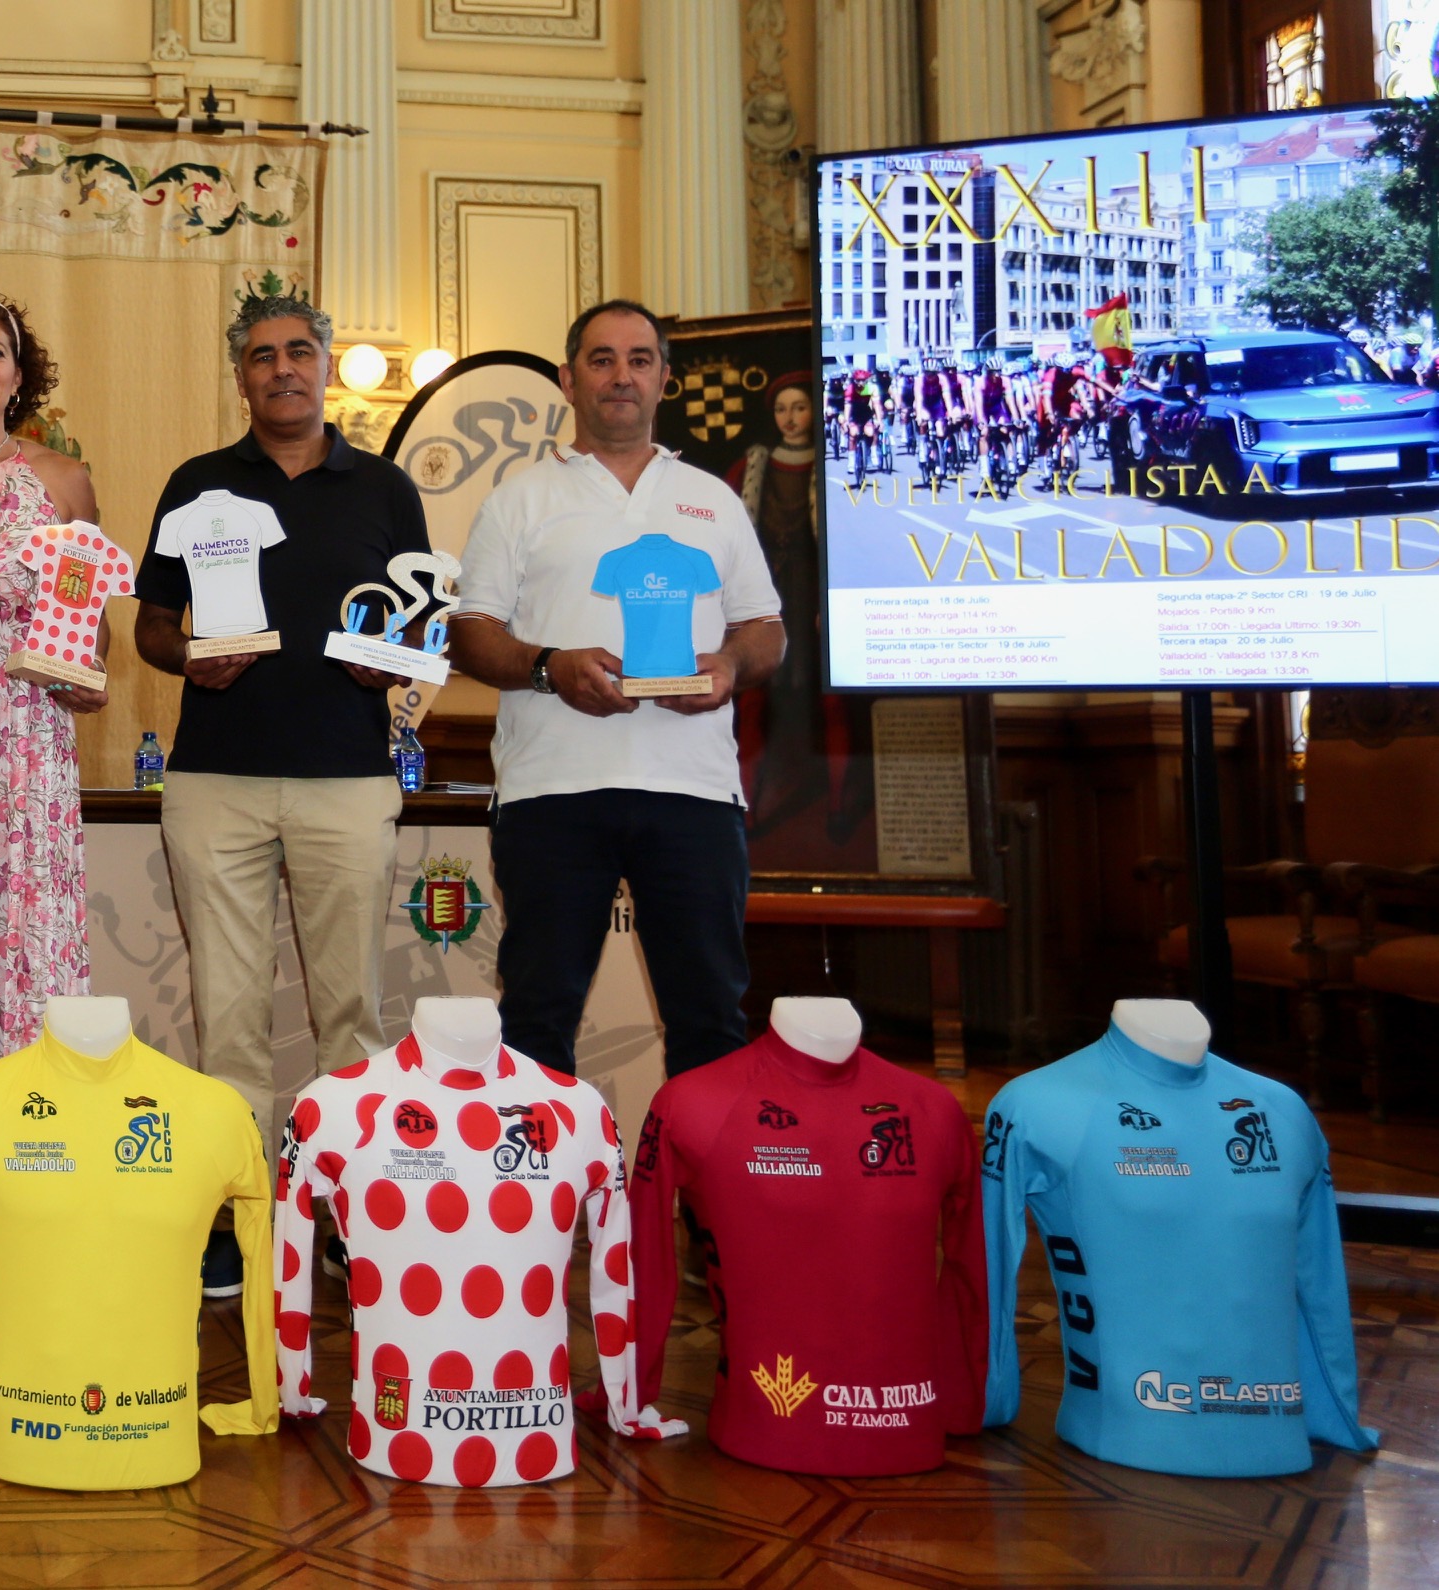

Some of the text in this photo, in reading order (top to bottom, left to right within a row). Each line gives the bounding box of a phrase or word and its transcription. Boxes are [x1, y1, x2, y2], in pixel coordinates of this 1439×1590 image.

[894, 158, 968, 173] CAJA RURAL
[840, 146, 1209, 253] XXXIII
[844, 462, 1275, 507] VUELTA CICLISTA A
[678, 505, 714, 518] LORD
[192, 539, 249, 550] ALIMENTOS
[906, 517, 1439, 582] VALLADOLID
[63, 548, 97, 564] PORTILLO
[205, 548, 249, 557] VALLADOLID
[206, 560, 223, 569] gusto
[865, 598, 900, 606] Primera
[903, 598, 929, 606] etapa
[968, 596, 990, 604] Julio
[1157, 592, 1202, 602] Segunda
[1251, 591, 1284, 599] Sector
[1288, 590, 1308, 598] CRI
[1320, 590, 1332, 598] 19
[1335, 589, 1348, 597] de
[1352, 589, 1376, 597] Julio
[866, 612, 908, 620] Valladolid
[918, 612, 958, 621] Mayorga
[981, 610, 997, 618] Km
[1157, 608, 1200, 617] Mojados
[1210, 607, 1244, 615] Portillo
[1258, 606, 1275, 614] Km
[1240, 622, 1281, 631] Llegada
[1326, 620, 1361, 628] 19:30h
[866, 642, 906, 651] Segunda
[957, 641, 987, 649] Sector
[999, 640, 1009, 648] 19
[1012, 640, 1024, 648] de
[1027, 640, 1050, 648] Julio
[1159, 637, 1195, 645] Tercera
[1199, 638, 1227, 646] etapa
[1253, 636, 1265, 644] de
[1269, 636, 1294, 644] Julio
[866, 656, 911, 664] Simancas
[920, 656, 955, 665] Laguna
[958, 655, 970, 663] de
[973, 655, 1002, 663] Duero
[1159, 652, 1207, 660] Valladolid
[1217, 651, 1266, 659] Valladolid
[1159, 667, 1191, 676] Salida:
[1198, 667, 1216, 675] 10h
[1274, 667, 1309, 675] 13:30h
[38, 1142, 66, 1150] CICLISTA
[753, 1146, 810, 1155] VUELTA CICLISTA
[390, 1149, 446, 1159] VUELTA CICLISTA
[4, 1158, 75, 1172] VALLADOLID
[746, 1162, 822, 1176] VALLADOLID
[1115, 1162, 1191, 1176] VALLADOLID
[383, 1165, 456, 1180] VALLADOLID
[116, 1391, 132, 1407] de
[135, 1383, 187, 1405] Valladolid
[423, 1388, 545, 1404] AYUNTAMIENTO
[823, 1380, 936, 1409] CAJA RURAL
[1200, 1382, 1301, 1402] CLASTOS
[422, 1403, 565, 1431] PORTILLO
[826, 1411, 909, 1428] DE ZAMORA
[11, 1417, 170, 1441] FMD Fundación Municipal
[87, 1431, 149, 1442] de Deportes
